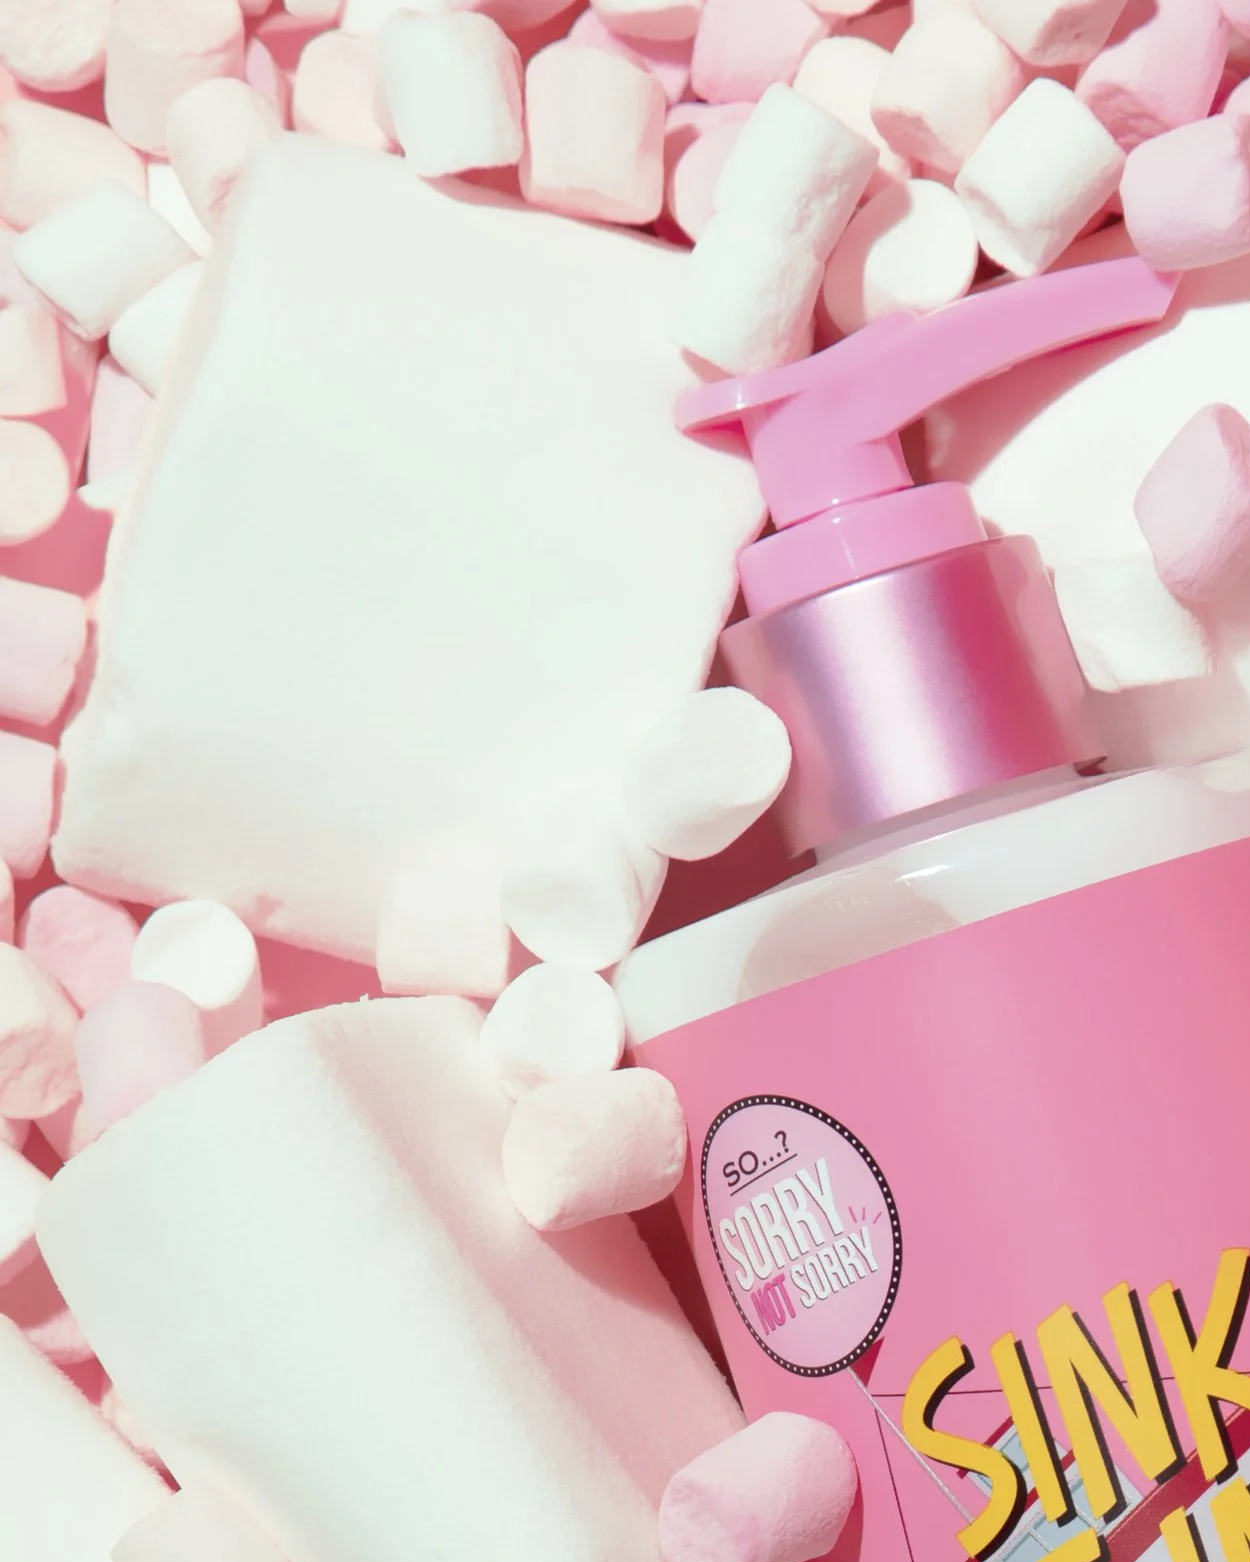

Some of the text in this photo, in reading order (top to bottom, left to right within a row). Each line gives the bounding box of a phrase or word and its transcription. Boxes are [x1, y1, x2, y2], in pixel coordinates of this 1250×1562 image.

[719, 1158, 845, 1291] SORRY
[751, 1226, 879, 1336] NOT SORRY
